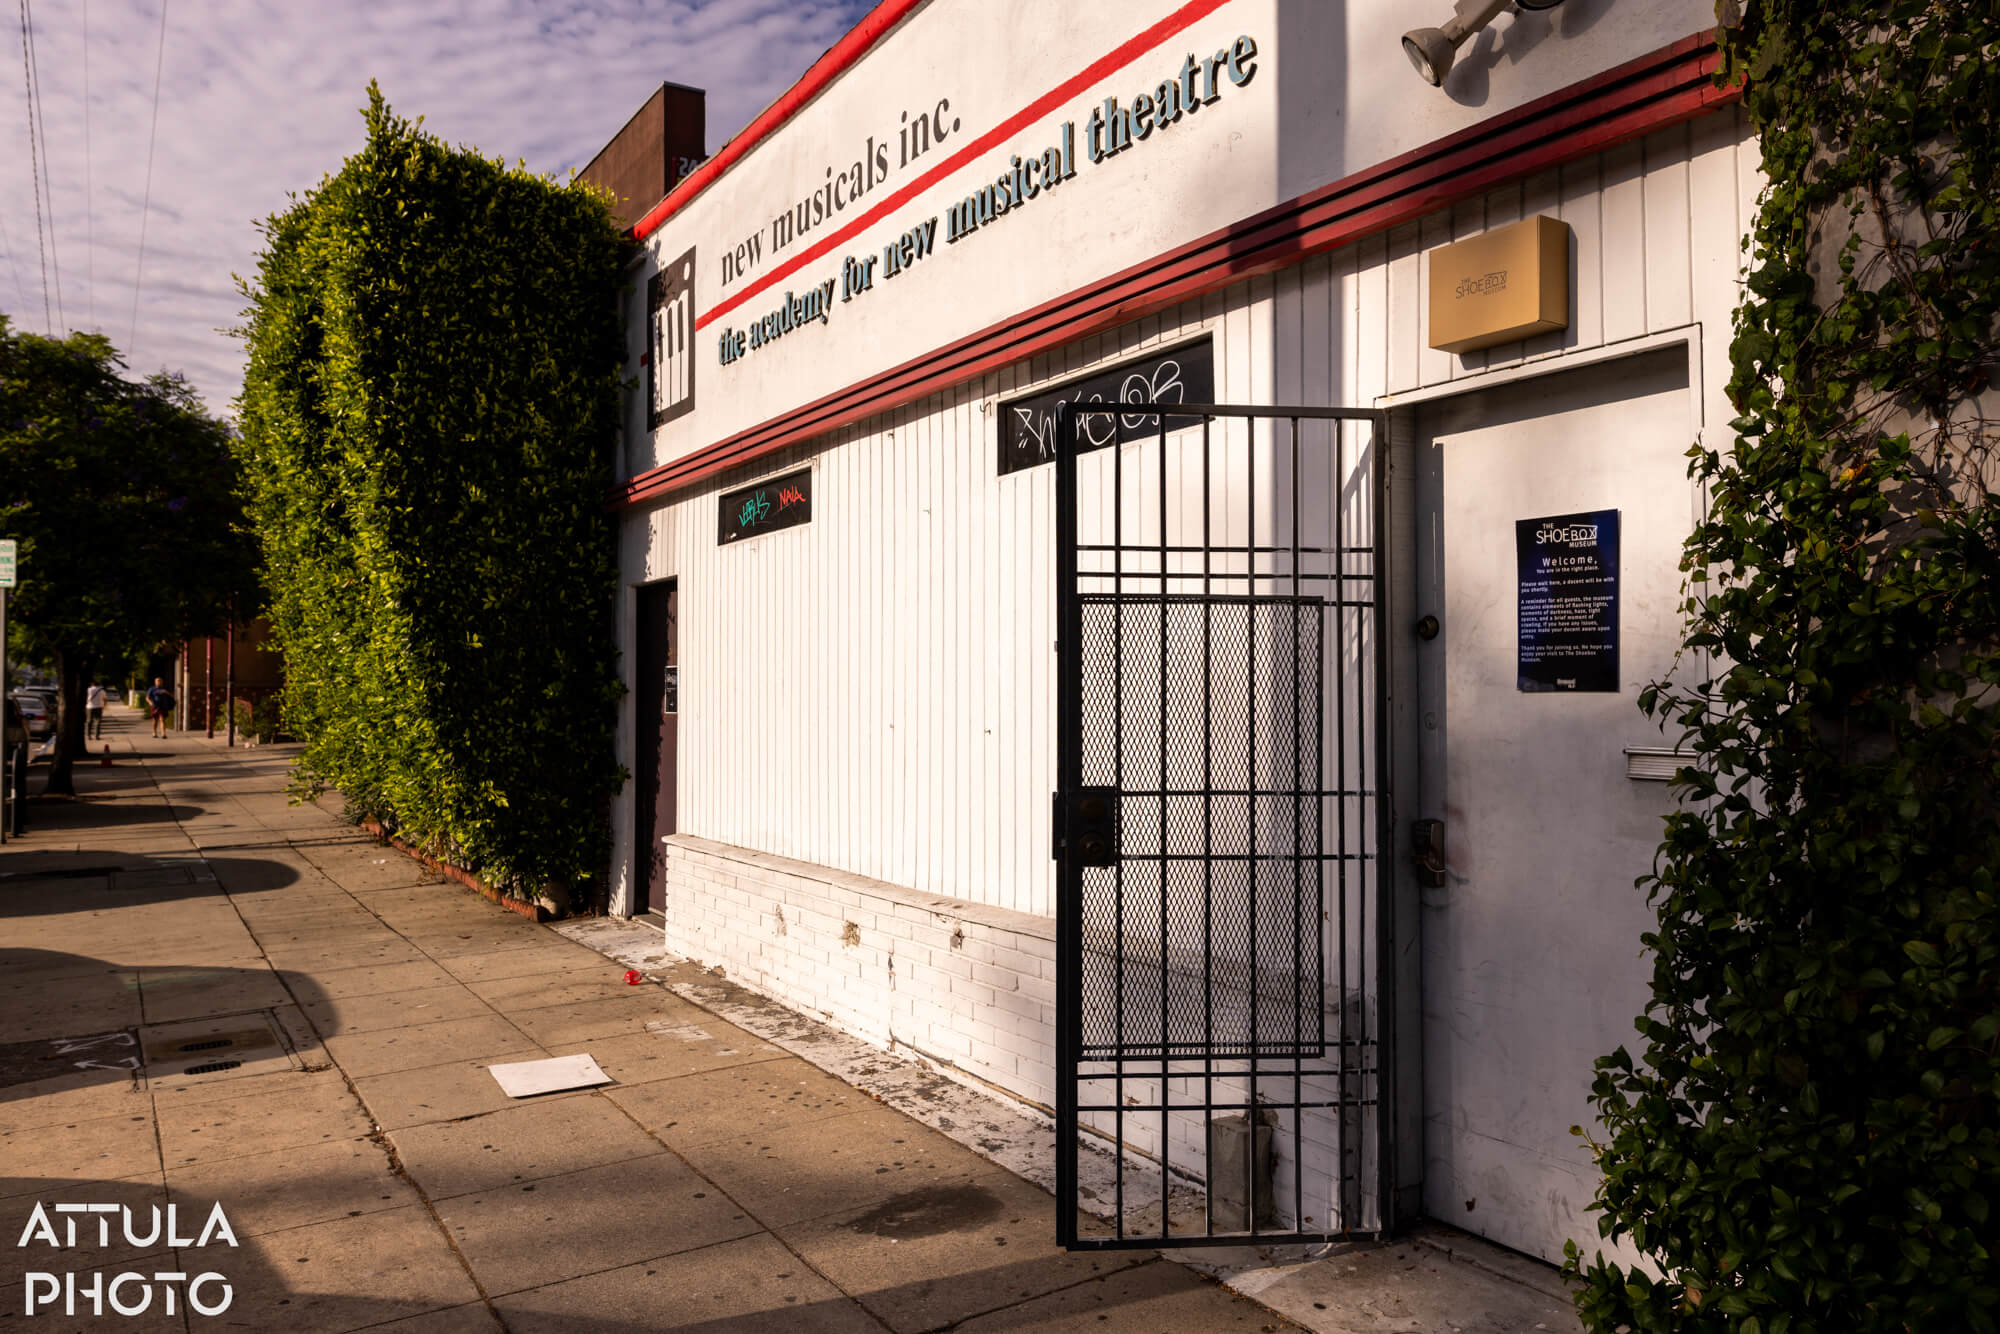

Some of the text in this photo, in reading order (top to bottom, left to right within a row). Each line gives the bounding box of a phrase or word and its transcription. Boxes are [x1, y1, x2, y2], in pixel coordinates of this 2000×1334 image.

[718, 35, 1258, 366] the academy for new musical theatre
[722, 98, 961, 286] new musicals inc.
[1456, 272, 1507, 299] SHOEBOX
[1536, 525, 1598, 544] SHOEBOX
[1569, 540, 1597, 548] MUSEUM
